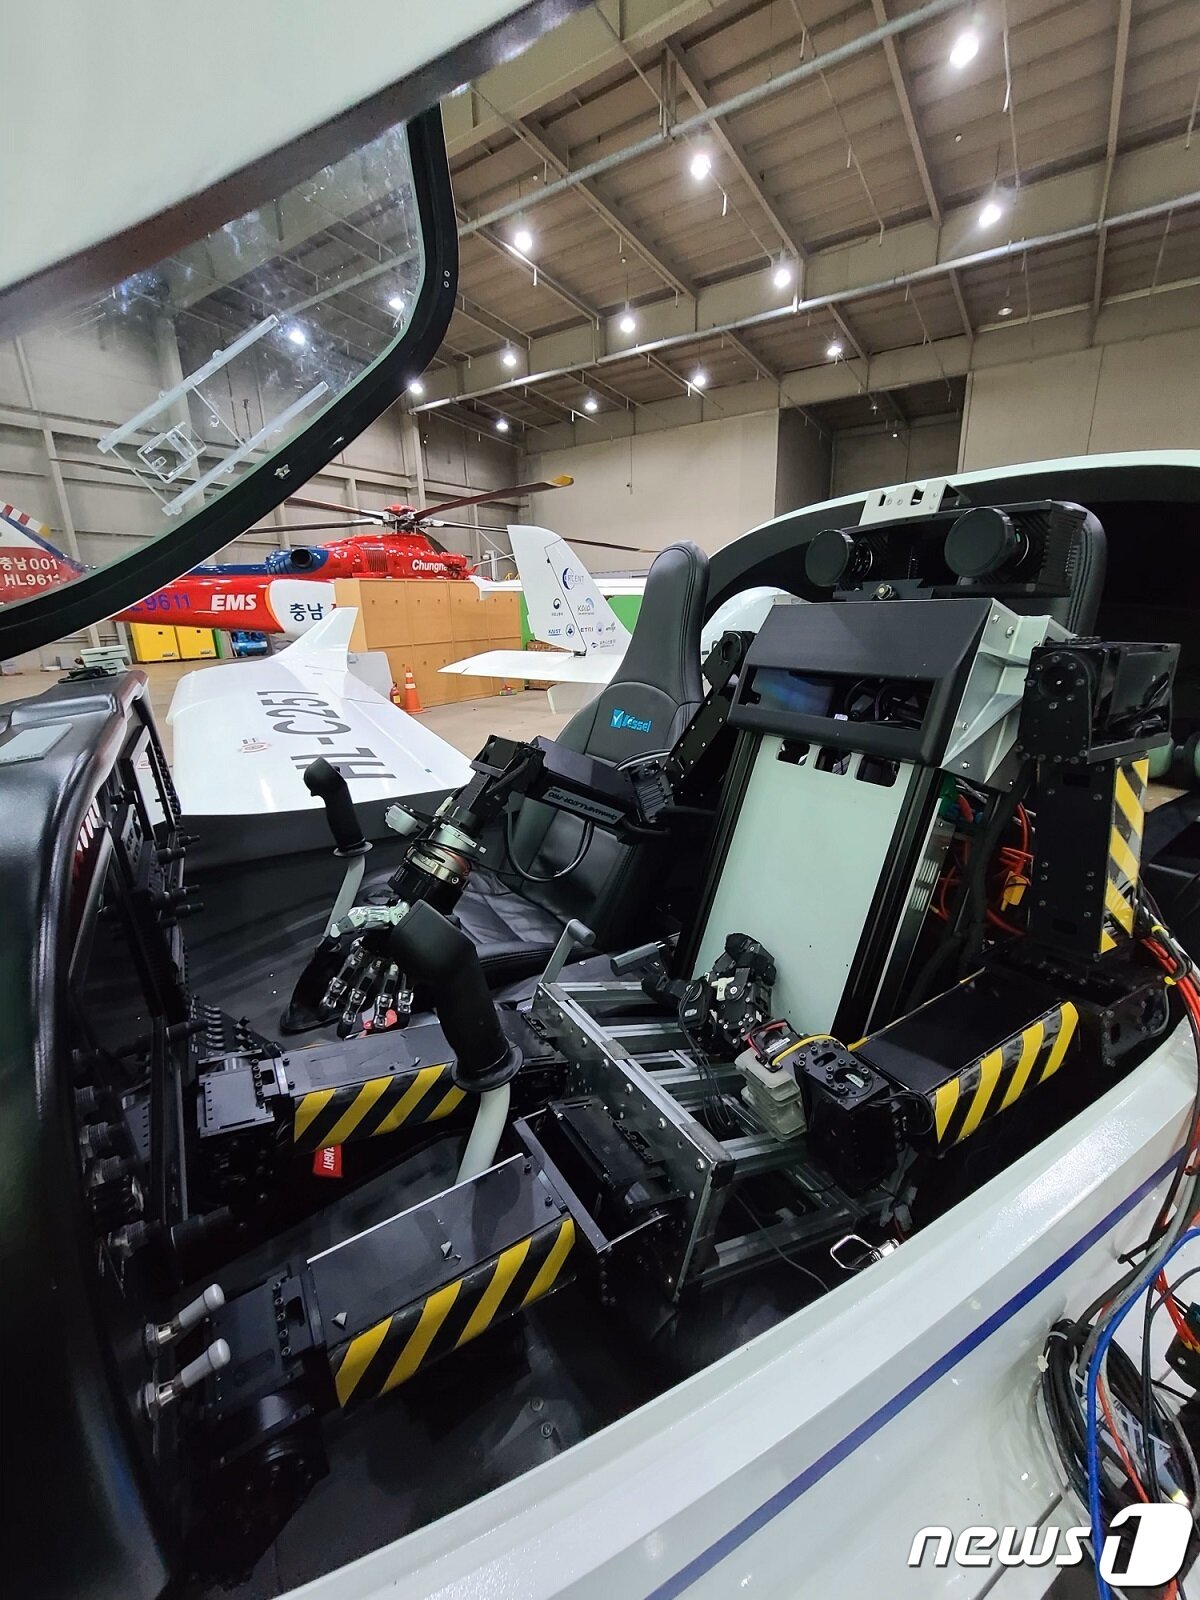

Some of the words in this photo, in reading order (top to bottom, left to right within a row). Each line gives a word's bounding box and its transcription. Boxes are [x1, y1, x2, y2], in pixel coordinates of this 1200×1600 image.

[0, 556, 27, 571] 충남
[30, 558, 58, 570] 001
[211, 594, 257, 611] EMS
[290, 603, 324, 622] 충남
[256, 691, 397, 779] HL-C251
